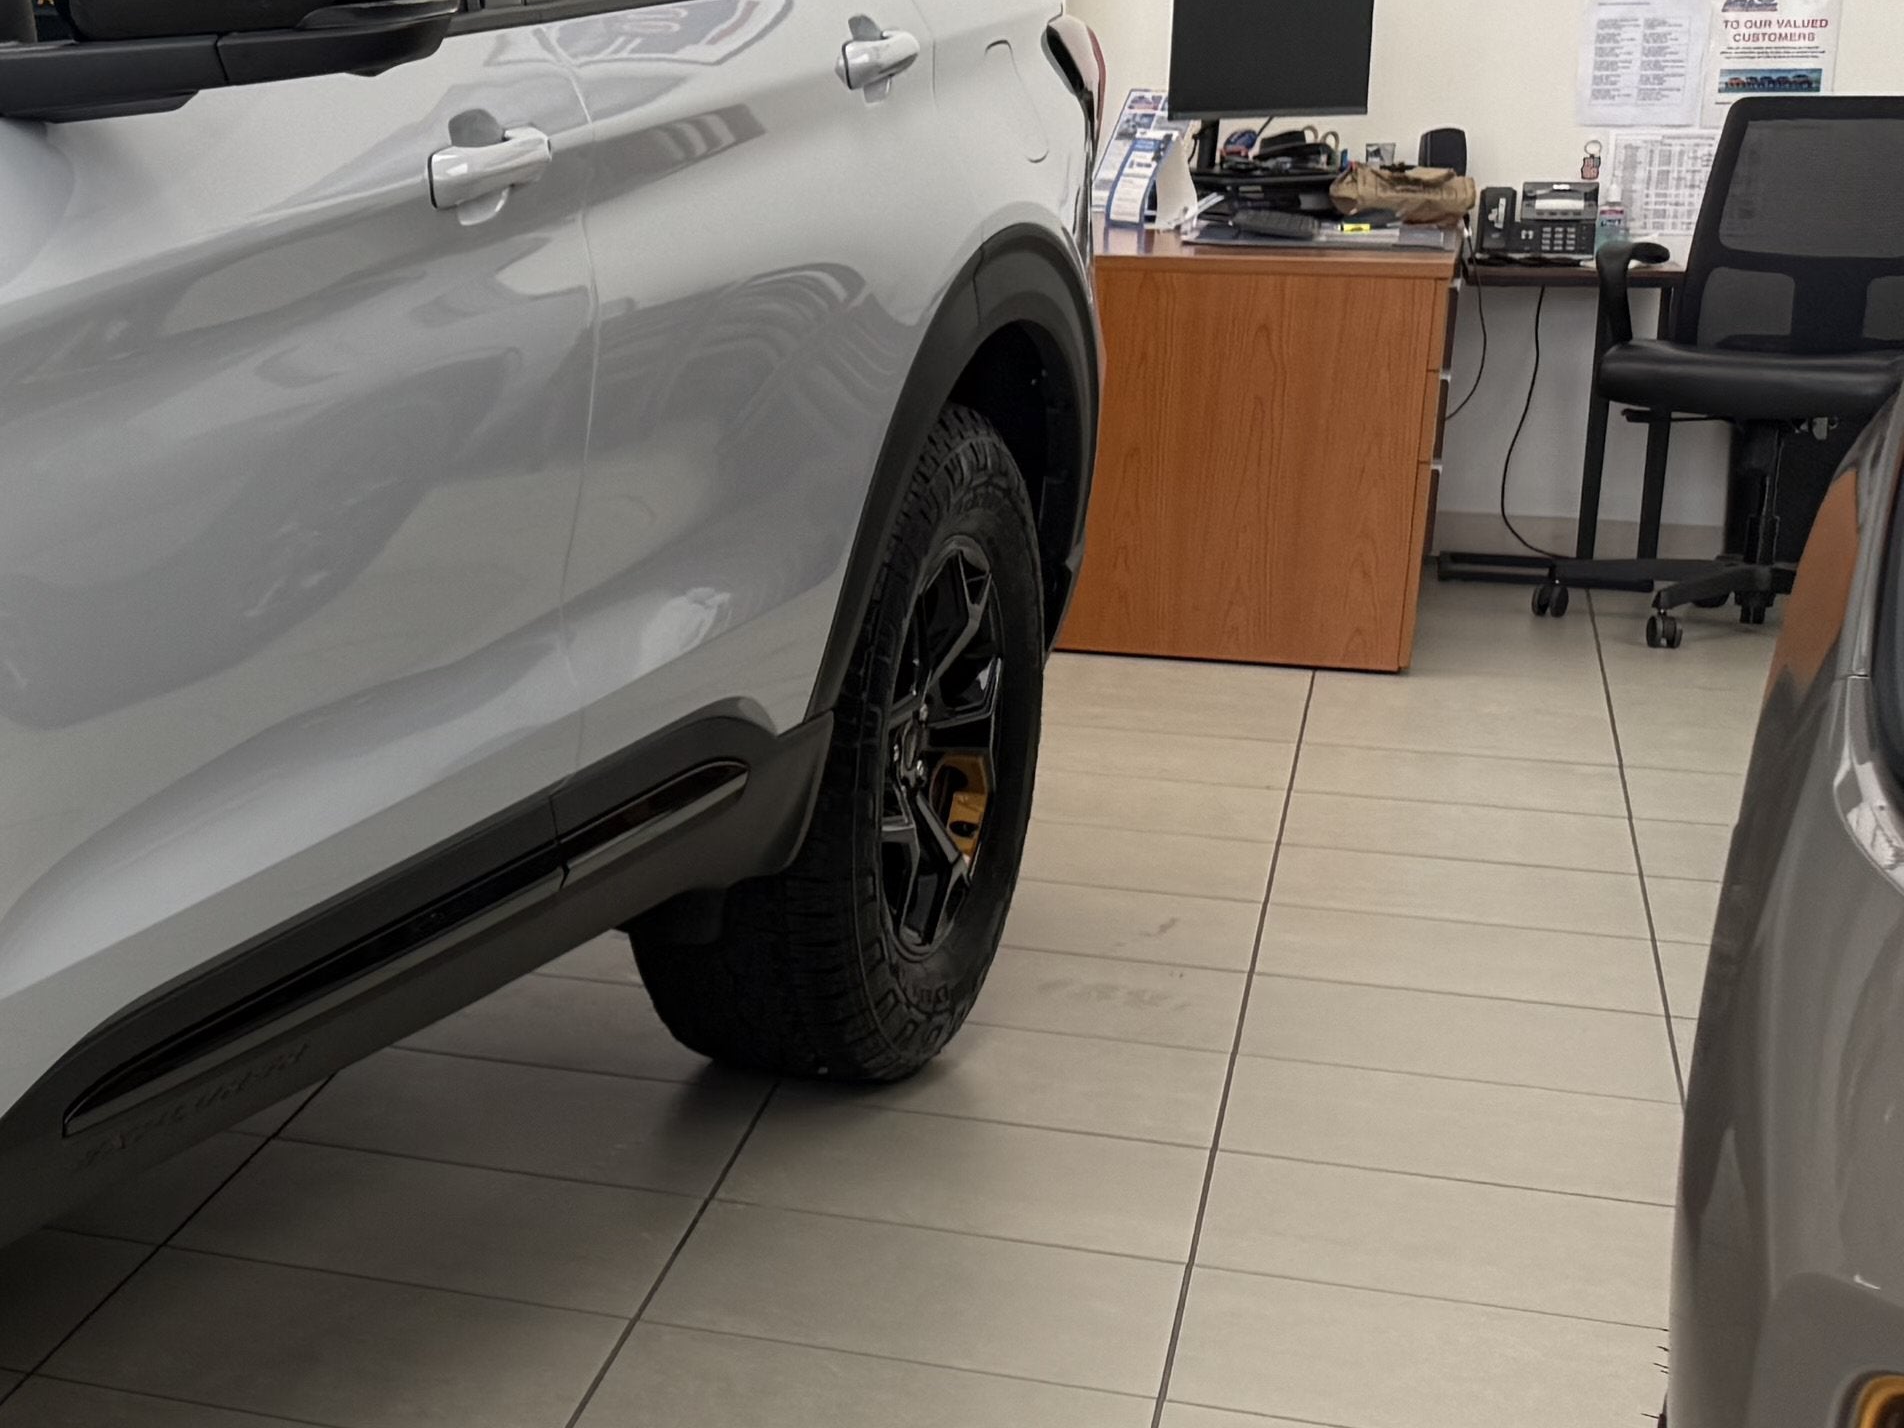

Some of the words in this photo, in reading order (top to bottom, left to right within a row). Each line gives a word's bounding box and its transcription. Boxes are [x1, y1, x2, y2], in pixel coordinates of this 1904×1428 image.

[1723, 19, 1741, 30] TO
[1744, 19, 1772, 29] OUR
[1776, 18, 1829, 29] VALUED
